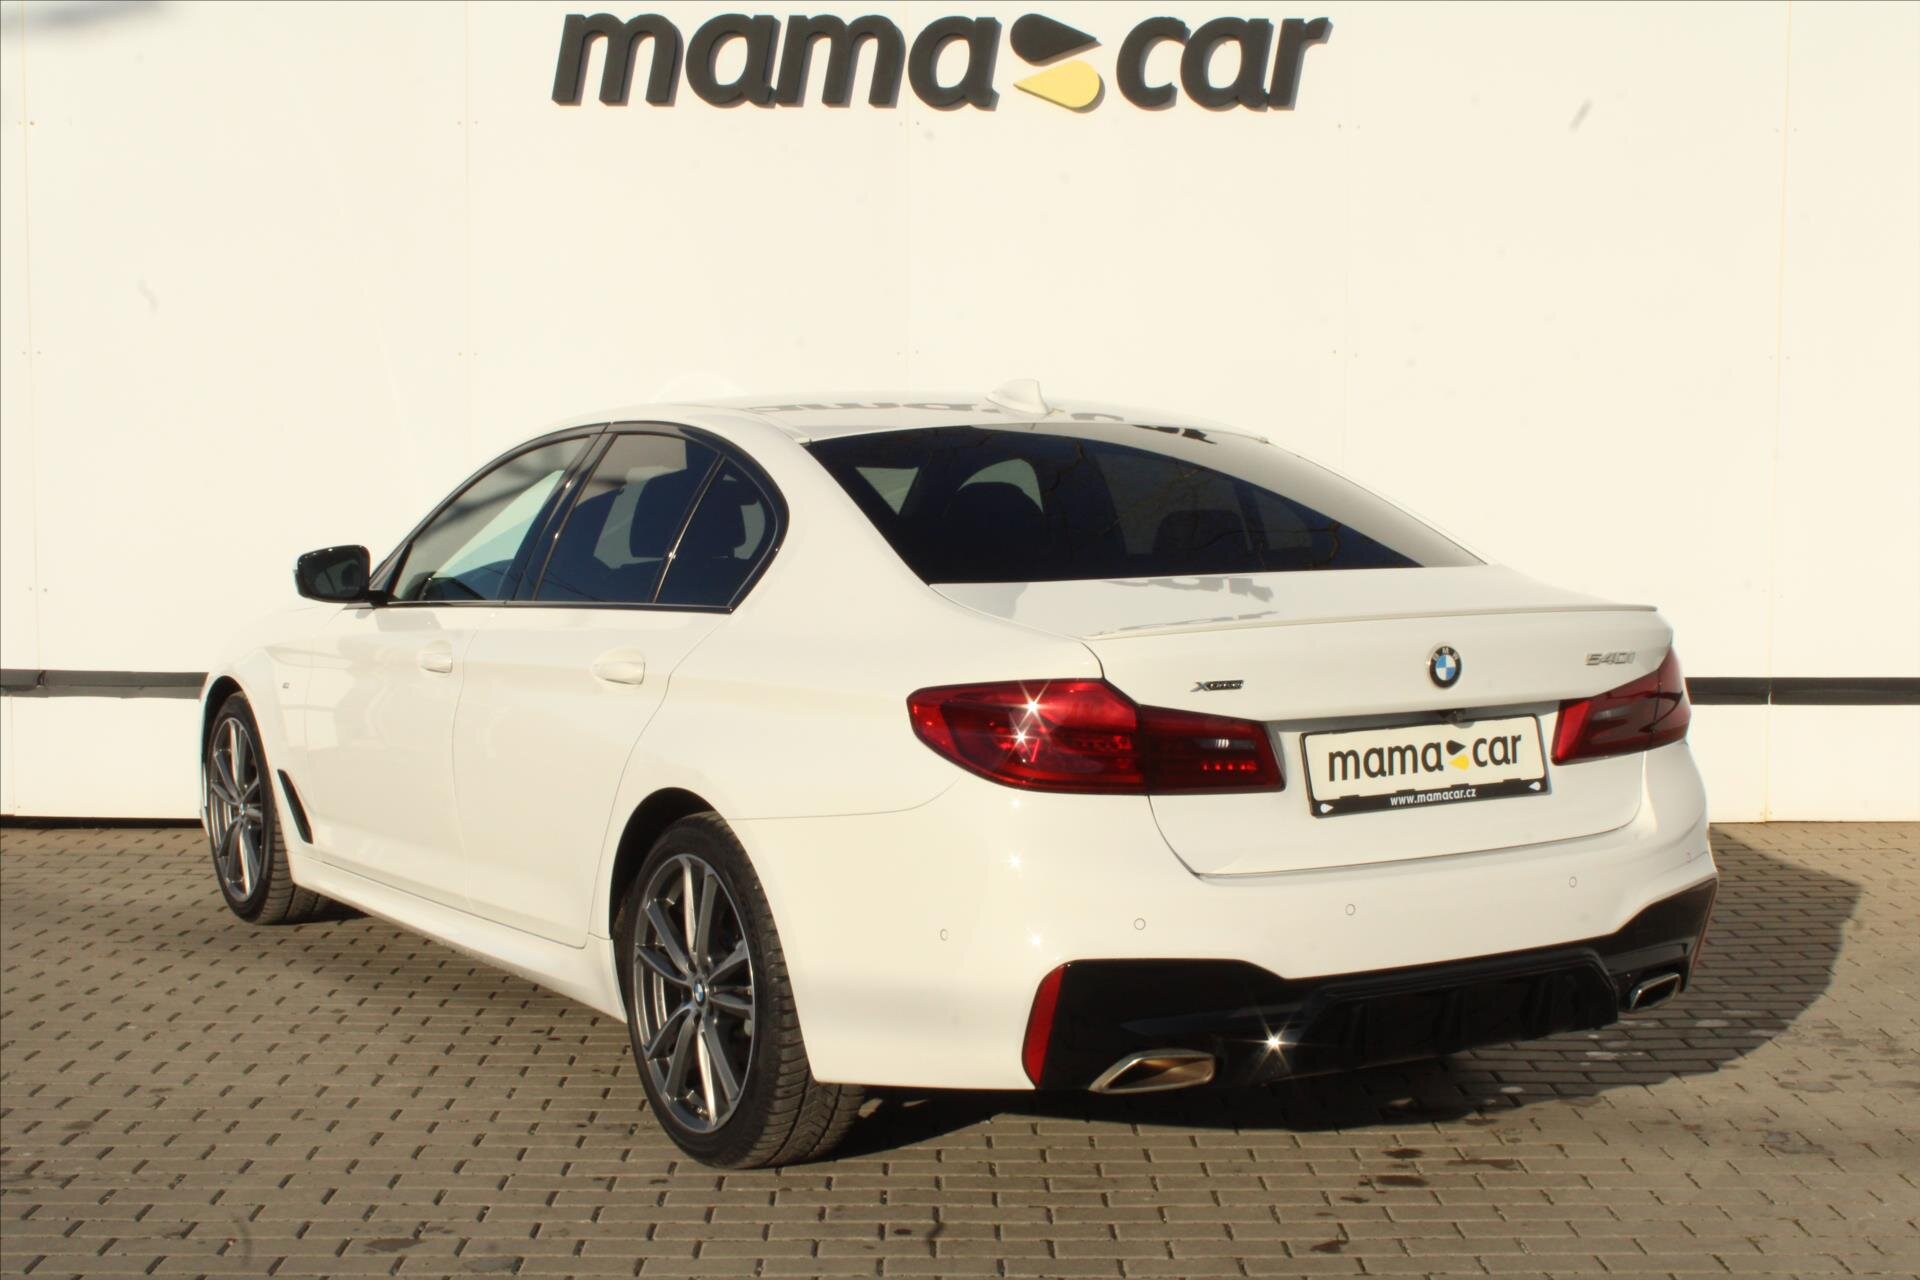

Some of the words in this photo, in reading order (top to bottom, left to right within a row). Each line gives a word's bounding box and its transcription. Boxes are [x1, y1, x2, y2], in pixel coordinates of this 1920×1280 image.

[552, 13, 1003, 110] mama
[1116, 14, 1334, 112] car
[1328, 741, 1444, 782] mama
[1472, 734, 1522, 768] car
[1390, 788, 1476, 806] www.mamacar.cz
